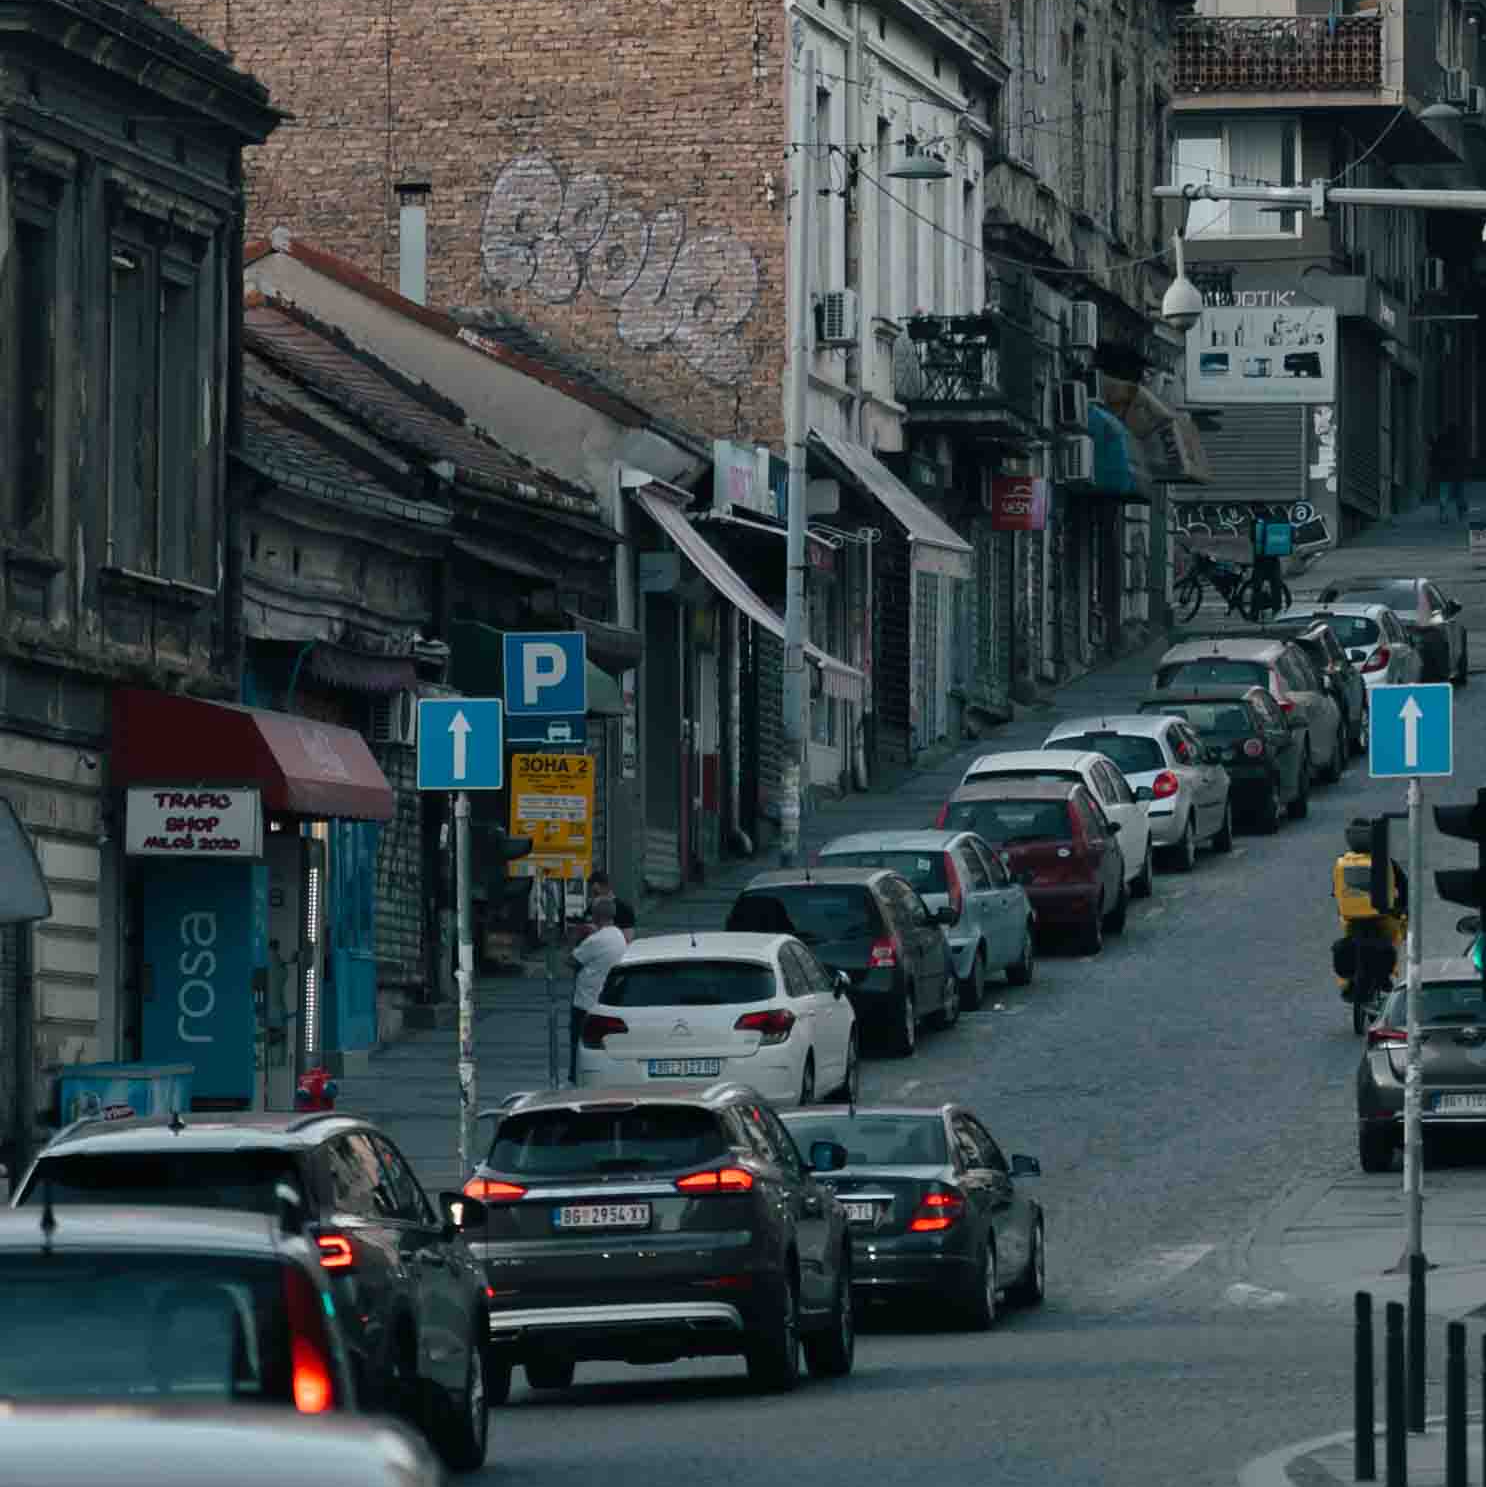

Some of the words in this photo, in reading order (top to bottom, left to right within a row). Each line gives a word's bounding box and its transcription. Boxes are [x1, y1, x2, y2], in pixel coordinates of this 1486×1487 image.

[523, 642, 567, 705] P
[519, 757, 569, 772] ЗОНА
[577, 759, 588, 772] 2
[154, 793, 232, 809] TRAFIC
[166, 816, 219, 832] SHOP
[178, 911, 217, 1042] rosa
